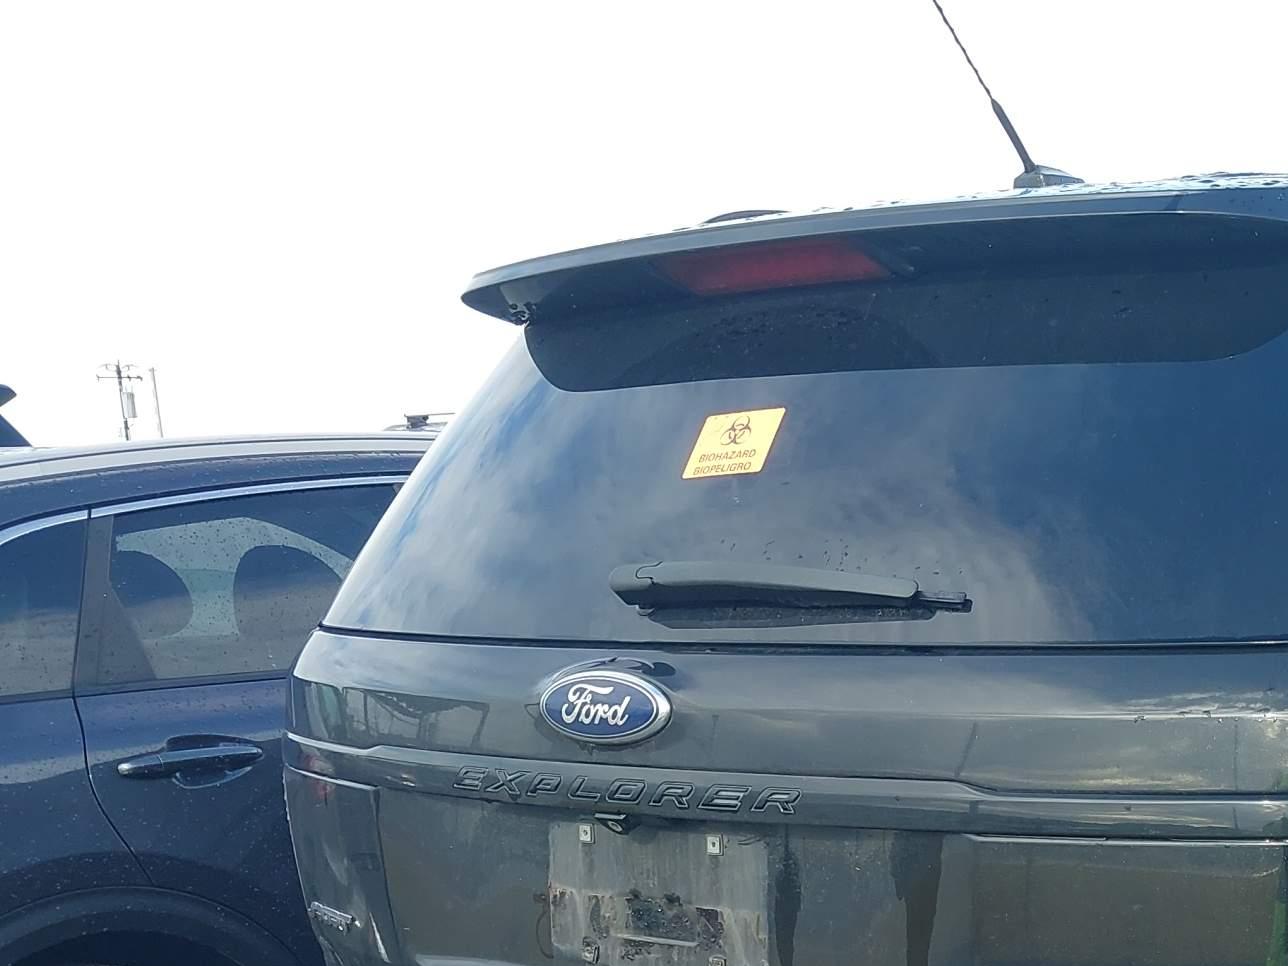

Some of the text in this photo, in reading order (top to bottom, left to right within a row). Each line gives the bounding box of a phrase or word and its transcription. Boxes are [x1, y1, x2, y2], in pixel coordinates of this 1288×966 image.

[693, 462, 752, 475] BIOPELIGRO
[699, 449, 756, 463] BIOHAZARD
[561, 683, 631, 727] Ford
[453, 765, 803, 814] EXPLORER
